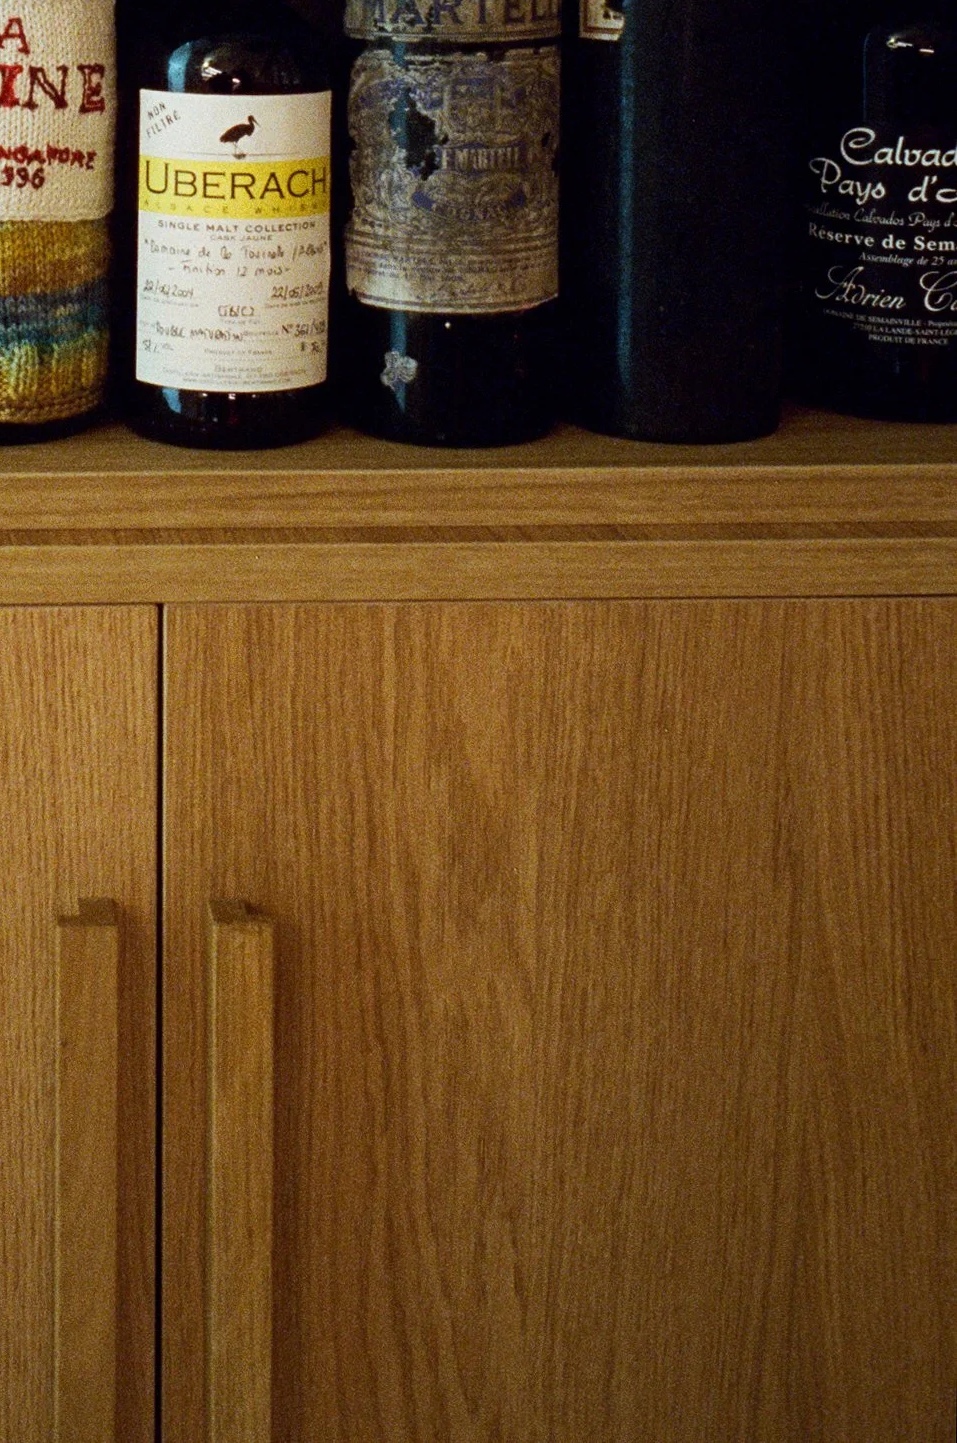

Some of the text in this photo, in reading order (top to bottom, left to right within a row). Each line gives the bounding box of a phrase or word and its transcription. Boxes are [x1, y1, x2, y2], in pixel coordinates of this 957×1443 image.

[147, 101, 167, 119] NON
[145, 159, 328, 200] UBERACH
[809, 156, 887, 206] Pays
[157, 219, 317, 233] SINGLE MALT COLLECTION
[853, 207, 942, 233] Calvados Pays
[808, 221, 957, 252] Réserve de Sem
[858, 251, 915, 268] Assemblage
[916, 255, 930, 266] de
[814, 265, 906, 310] Adrien
[917, 336, 949, 346] FRANCE
